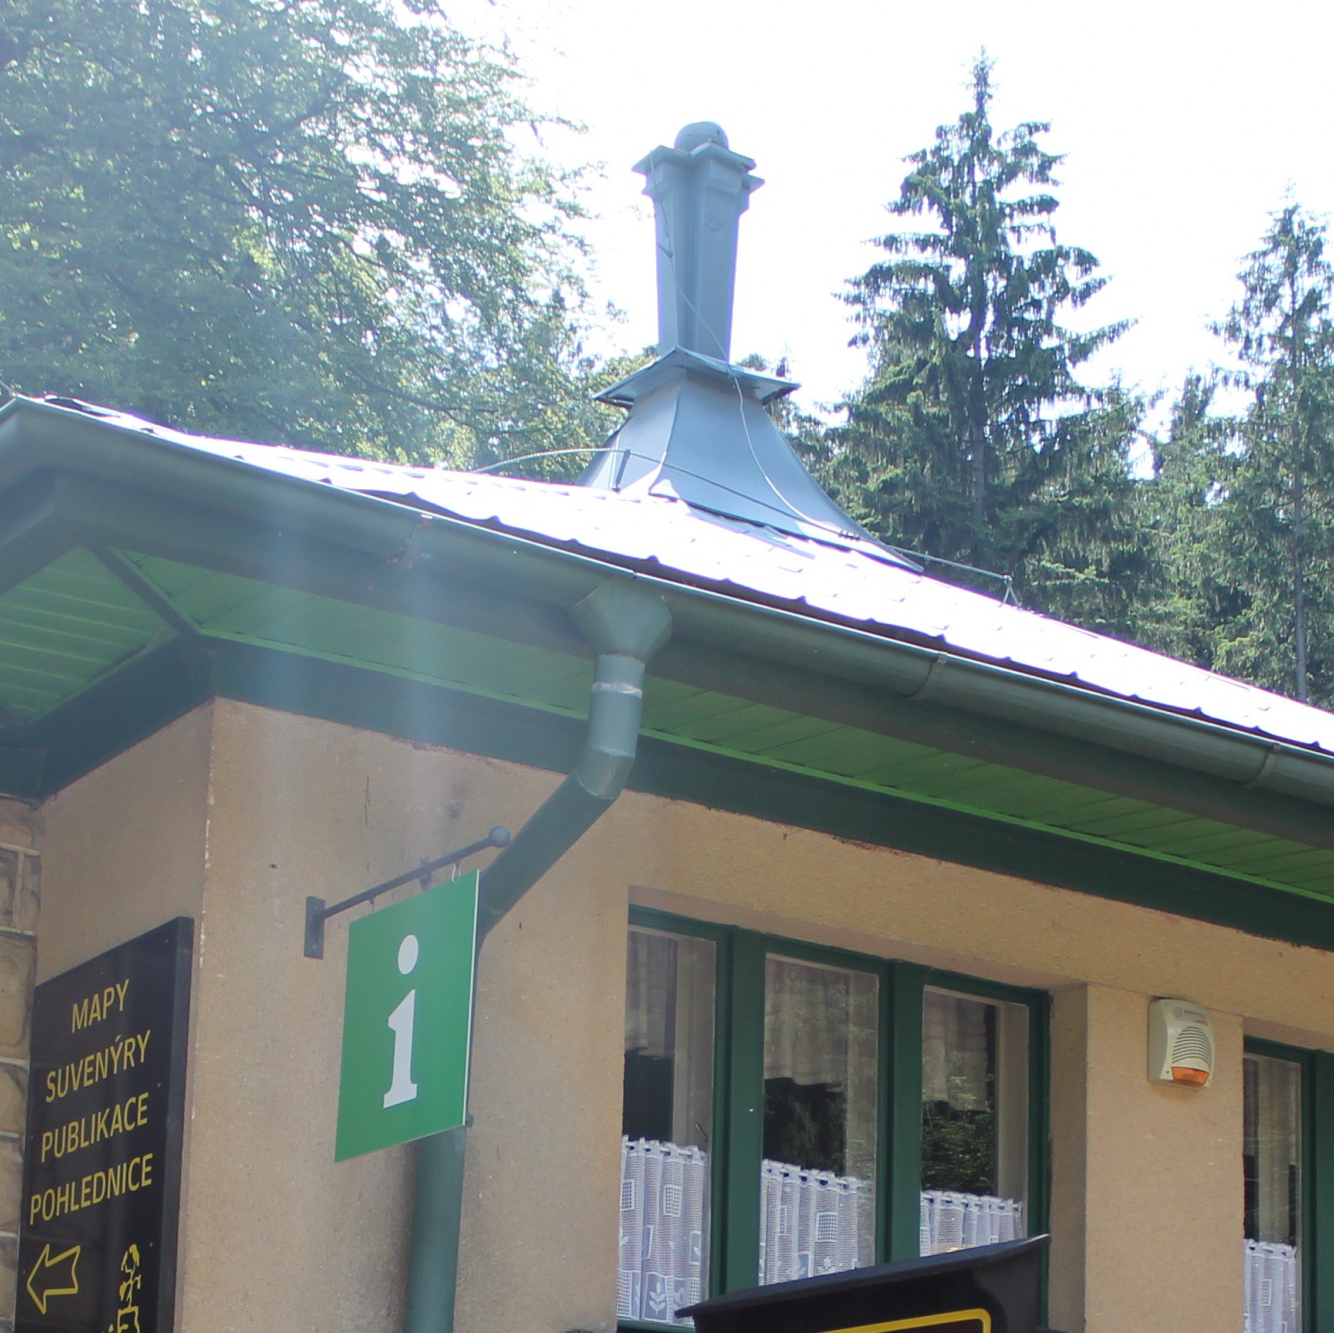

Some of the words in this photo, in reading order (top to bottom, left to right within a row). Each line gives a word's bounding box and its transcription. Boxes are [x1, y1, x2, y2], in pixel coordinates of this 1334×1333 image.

[71, 978, 129, 1034] MAPY
[45, 1029, 151, 1103] SUVENÝRY
[41, 1092, 149, 1163] PUBLIKACE
[29, 1153, 153, 1226] POHLEDNICE
